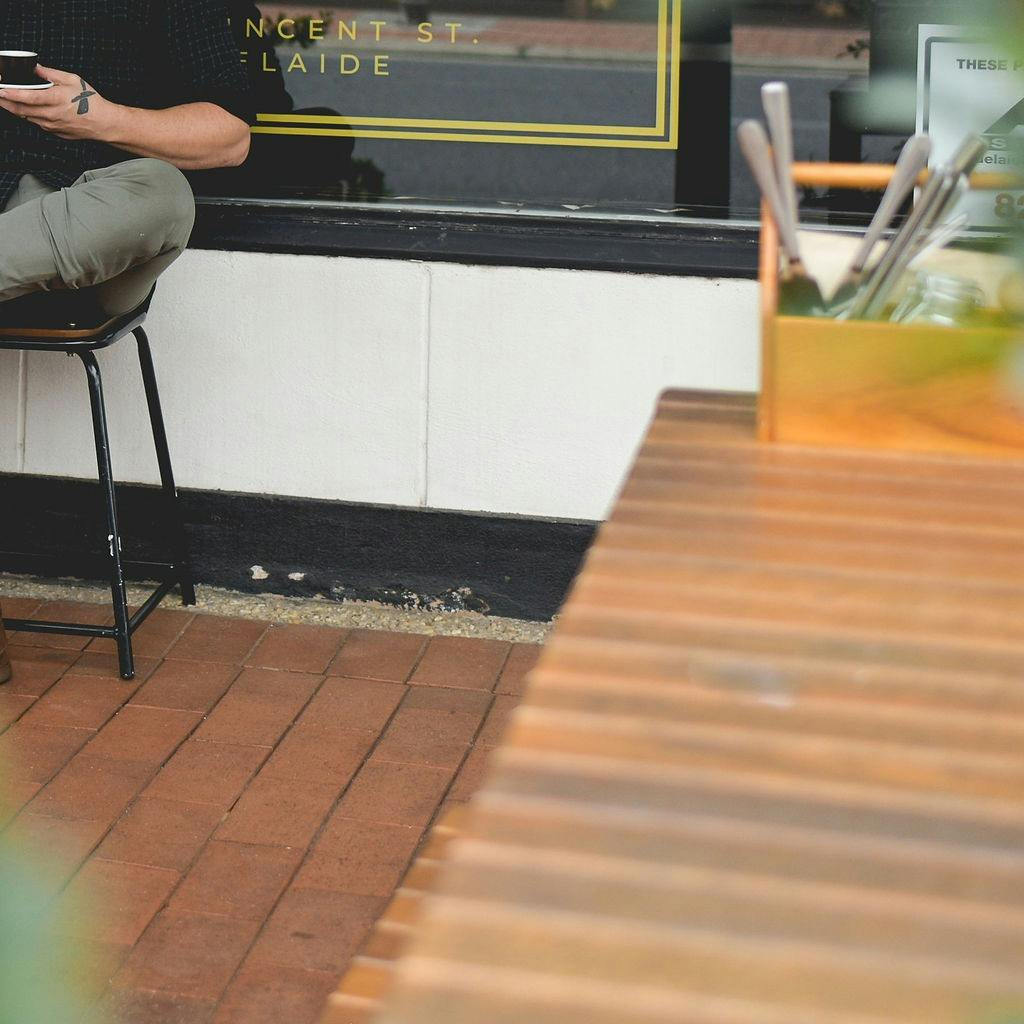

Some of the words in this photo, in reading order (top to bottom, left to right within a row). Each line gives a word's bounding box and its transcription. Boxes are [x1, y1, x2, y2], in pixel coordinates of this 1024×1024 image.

[227, 18, 387, 42] NCENT
[417, 22, 479, 45] ST.
[240, 52, 390, 77] LAIDE
[956, 58, 1008, 72] THESE
